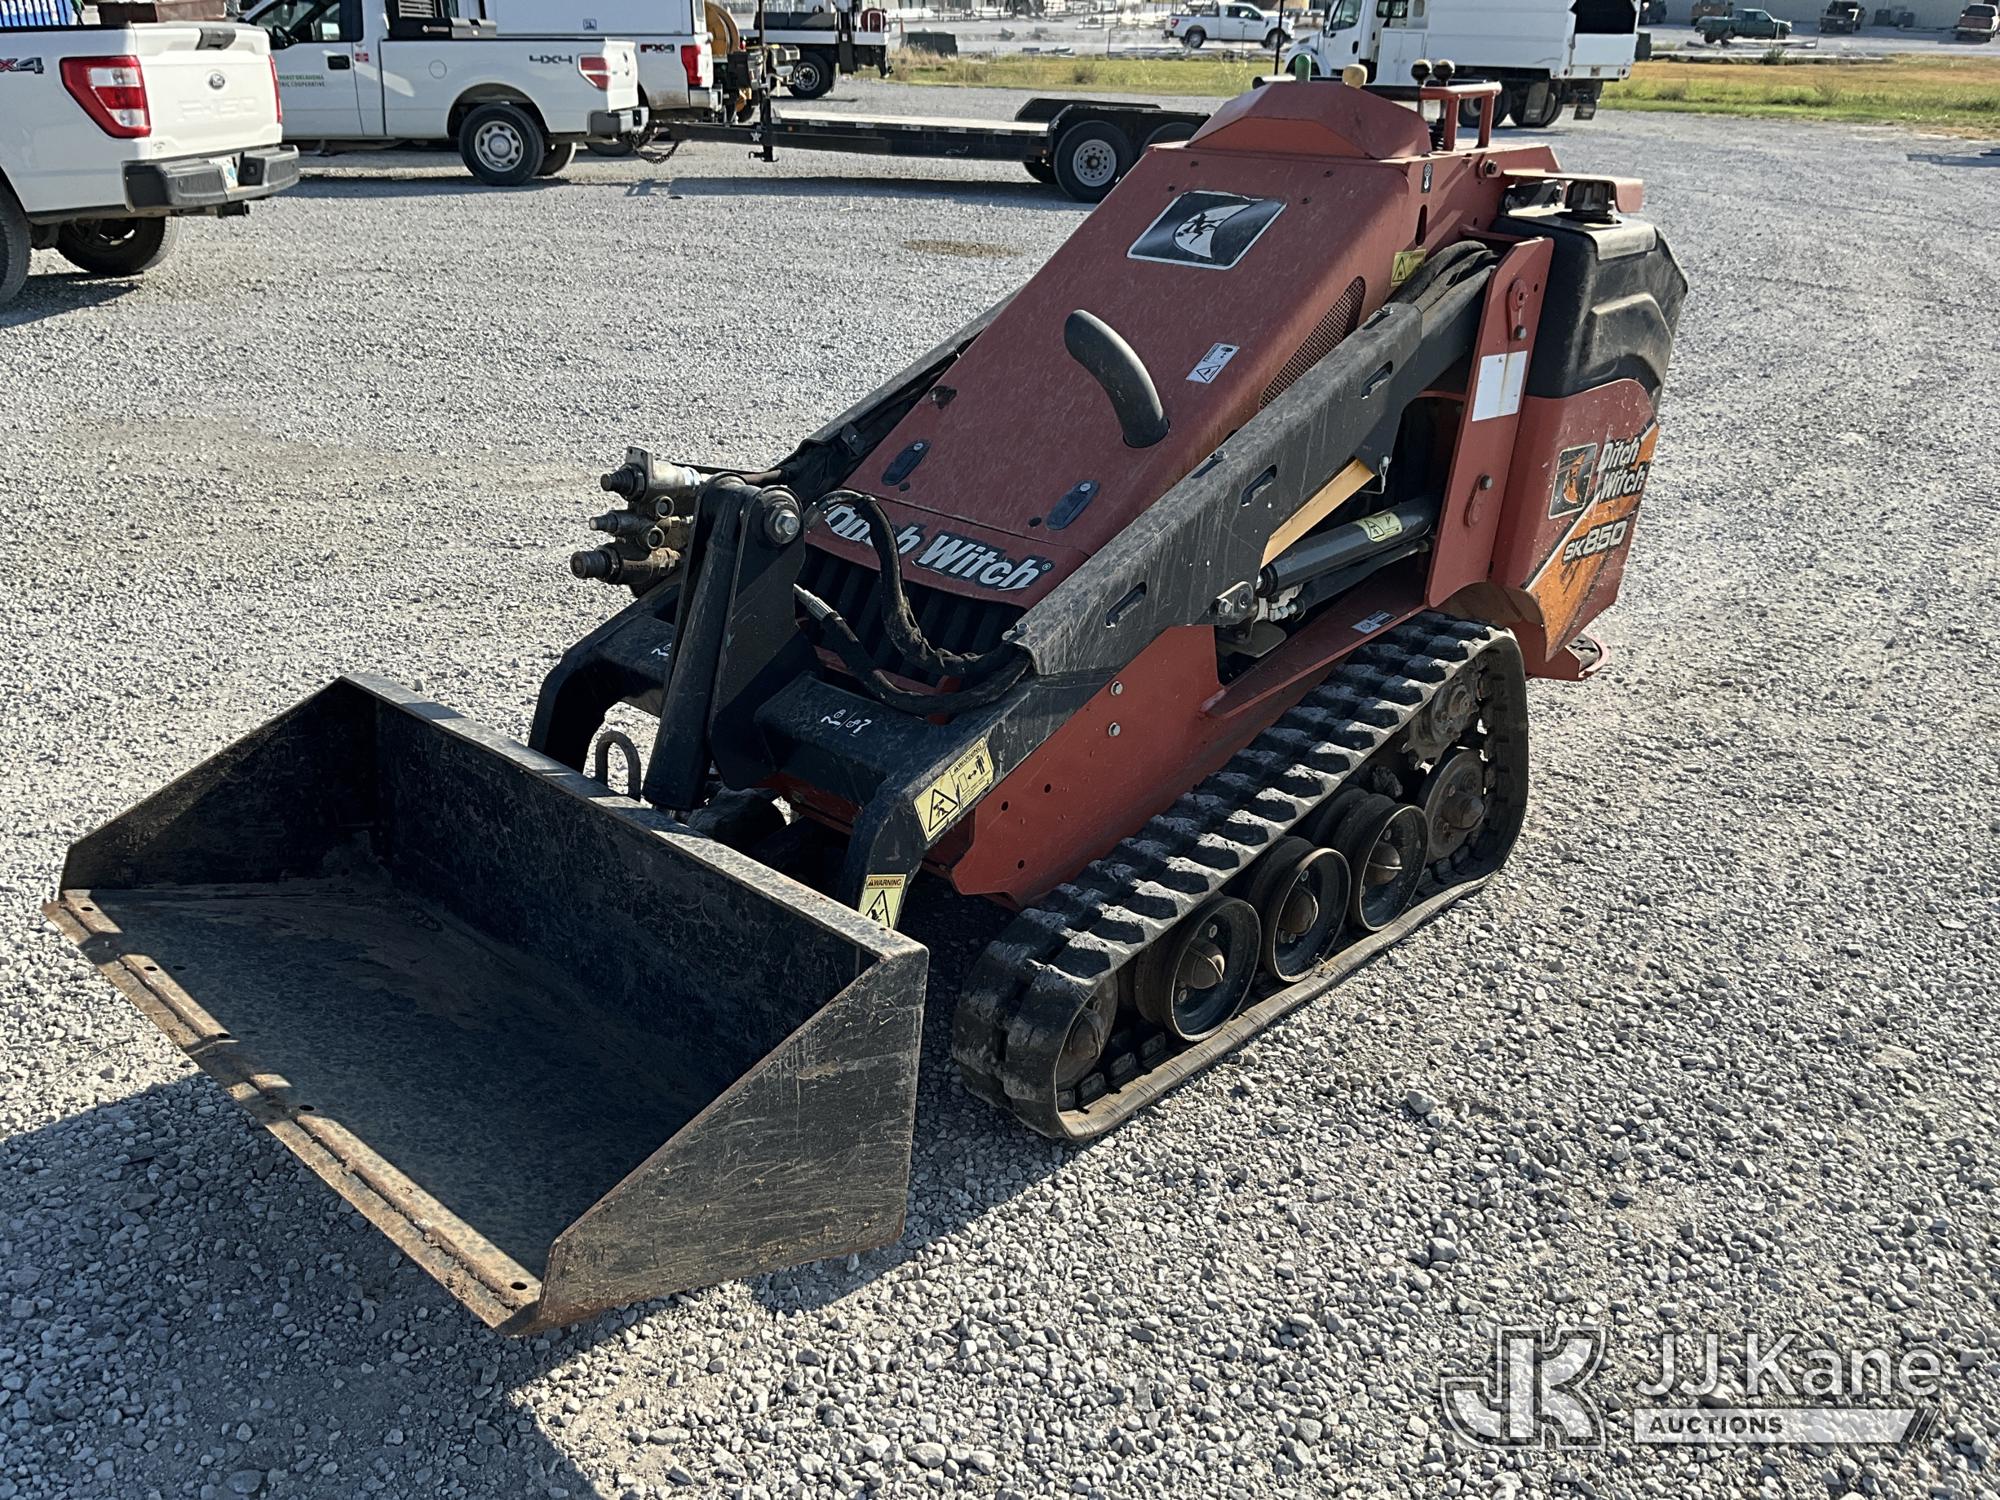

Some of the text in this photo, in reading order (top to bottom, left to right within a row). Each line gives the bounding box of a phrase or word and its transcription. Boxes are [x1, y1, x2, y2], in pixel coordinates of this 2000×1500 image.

[1598, 437, 1641, 472] Ditch
[1600, 464, 1646, 502] Witch
[1563, 520, 1627, 561] SK850
[872, 878, 902, 887] WARNING
